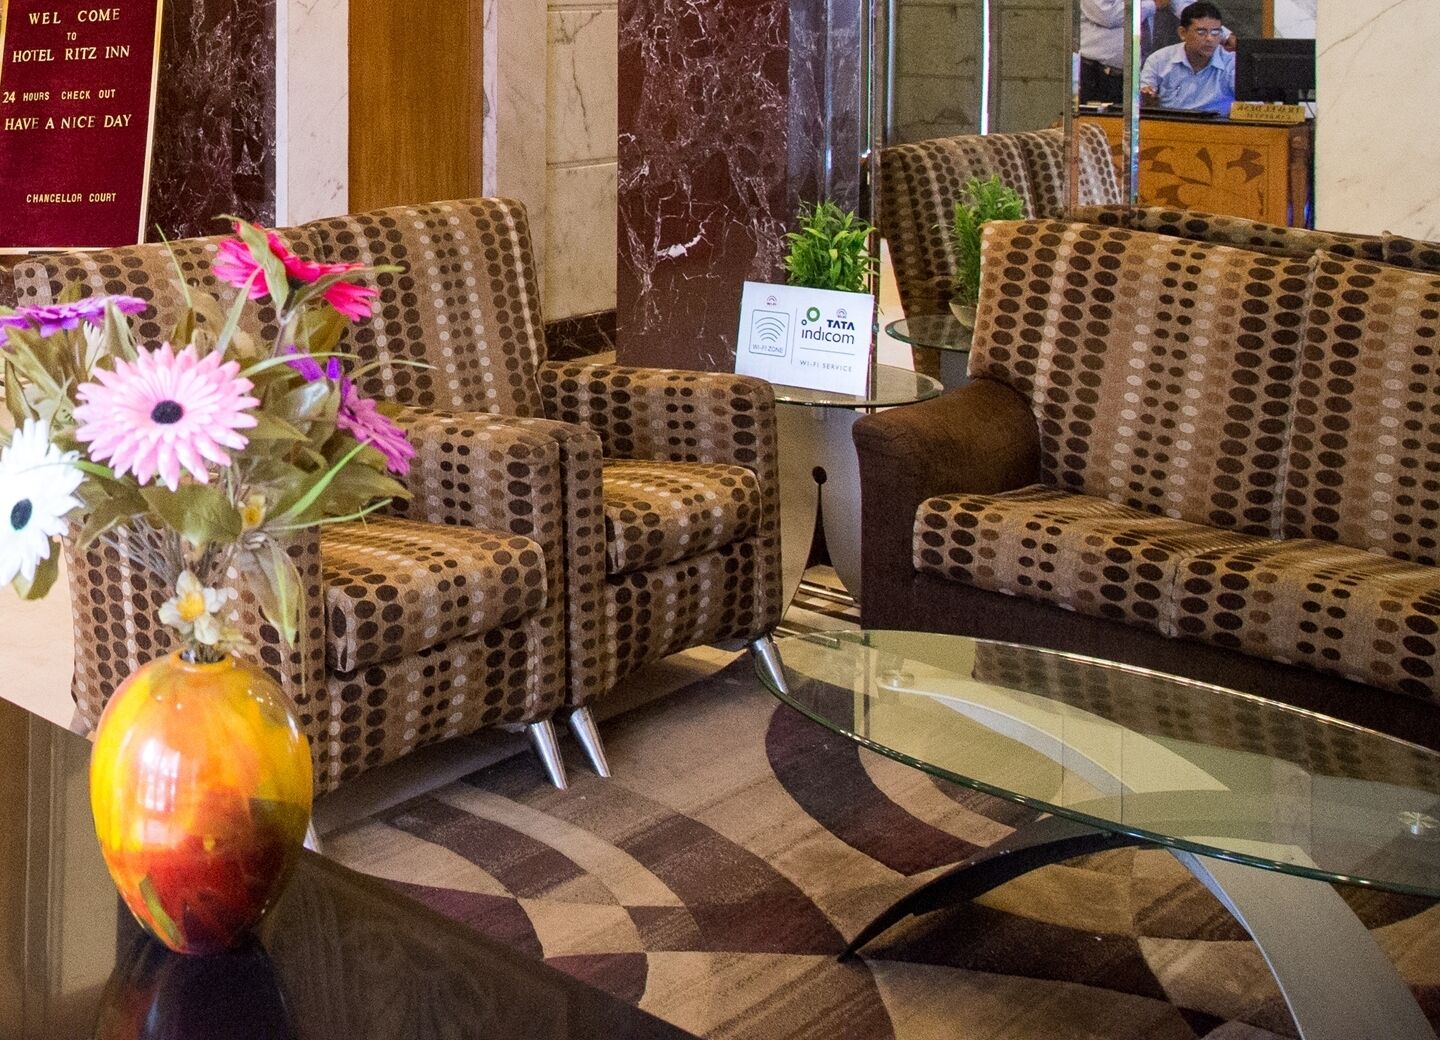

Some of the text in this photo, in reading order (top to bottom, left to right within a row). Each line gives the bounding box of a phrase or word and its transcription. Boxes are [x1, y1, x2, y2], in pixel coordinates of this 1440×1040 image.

[28, 8, 120, 25] WEL COME
[66, 31, 77, 41] TO
[12, 45, 131, 63] HOTEL RITZ INN
[2, 89, 116, 104] 24 HOURS CHECK OUT
[4, 114, 132, 131] HAVE A NICE DAY
[26, 192, 117, 203] CHANCELLOR COURT
[826, 319, 855, 331] TATA
[801, 326, 855, 345] indicom
[767, 345, 784, 353] ZONE
[822, 362, 852, 372] SERVICE
